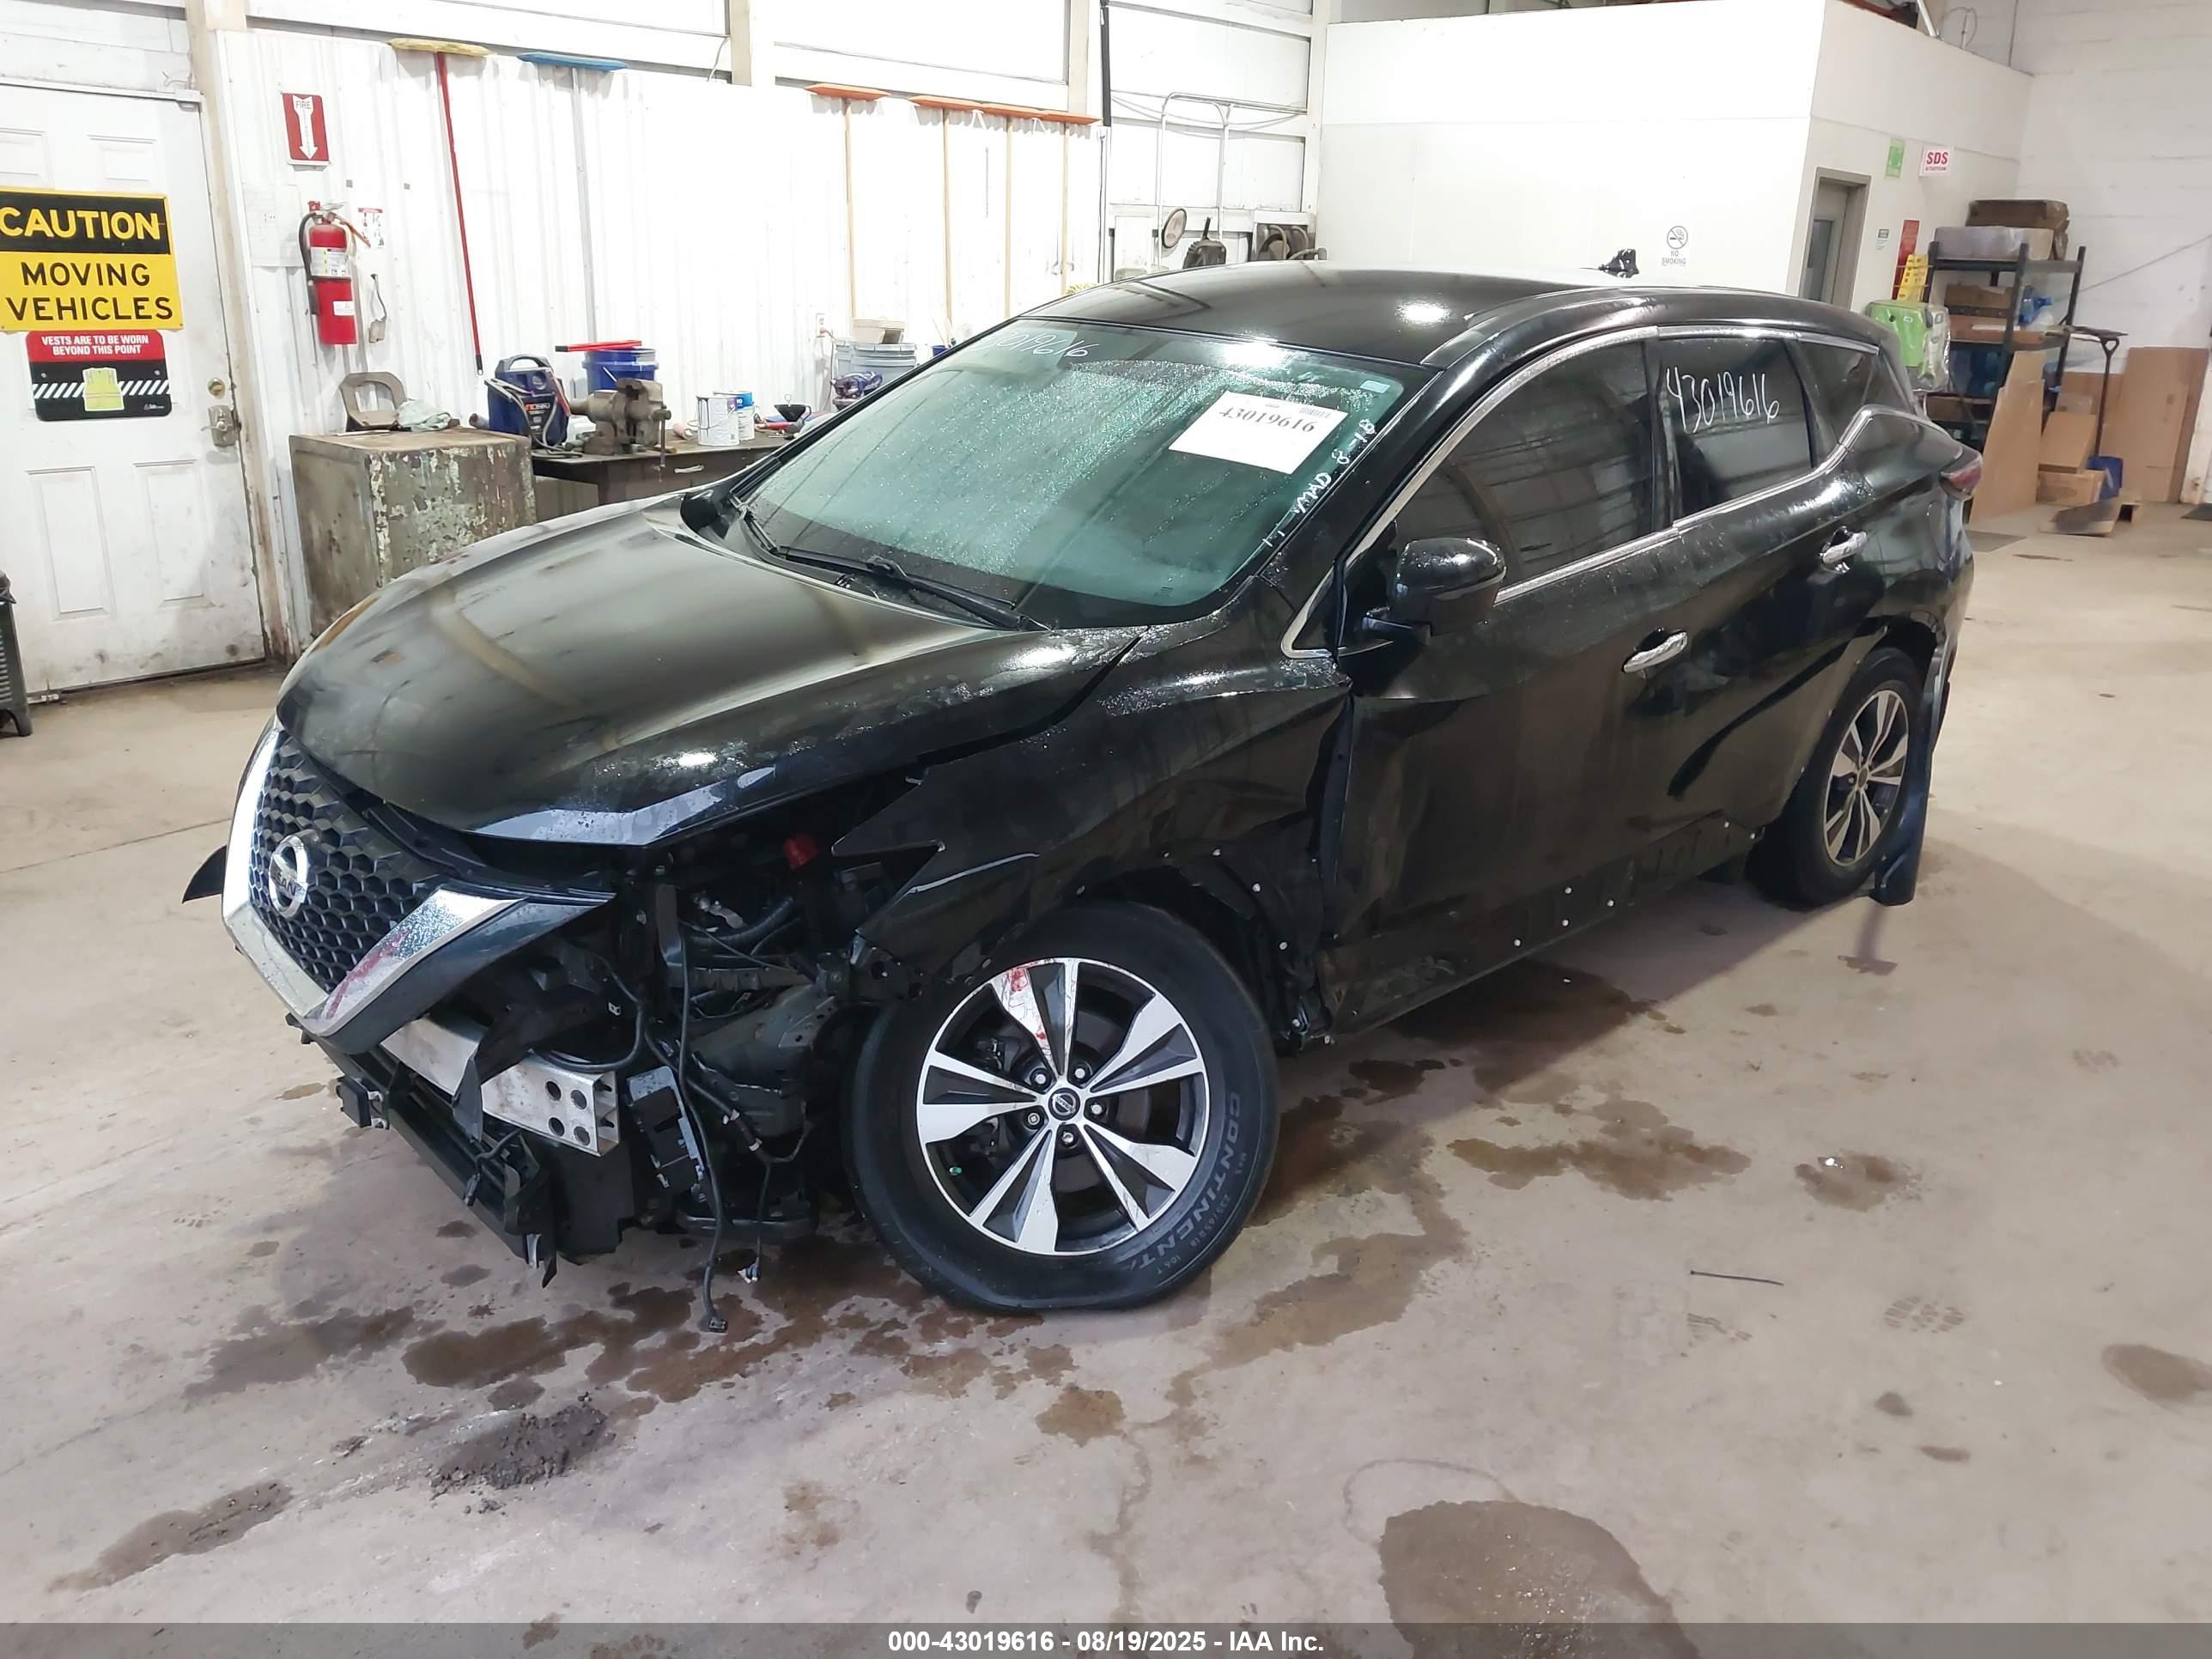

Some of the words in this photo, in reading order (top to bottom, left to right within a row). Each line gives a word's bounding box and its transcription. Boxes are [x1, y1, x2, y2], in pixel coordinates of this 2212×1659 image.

[1926, 151, 1948, 165] SDS
[0, 206, 161, 240] CAUTION
[21, 261, 150, 286] MOVING
[5, 296, 173, 320] VEHICLES
[41, 336, 71, 345] VESTS
[74, 335, 92, 345] ARE
[93, 335, 106, 344] TO
[107, 335, 118, 344] BE
[119, 334, 149, 344] WORN
[52, 346, 90, 356] BEYOND
[92, 345, 112, 355] THIS
[115, 344, 141, 354] POINT
[1666, 367, 1779, 434] 43019616
[1218, 406, 1319, 433] 43019616
